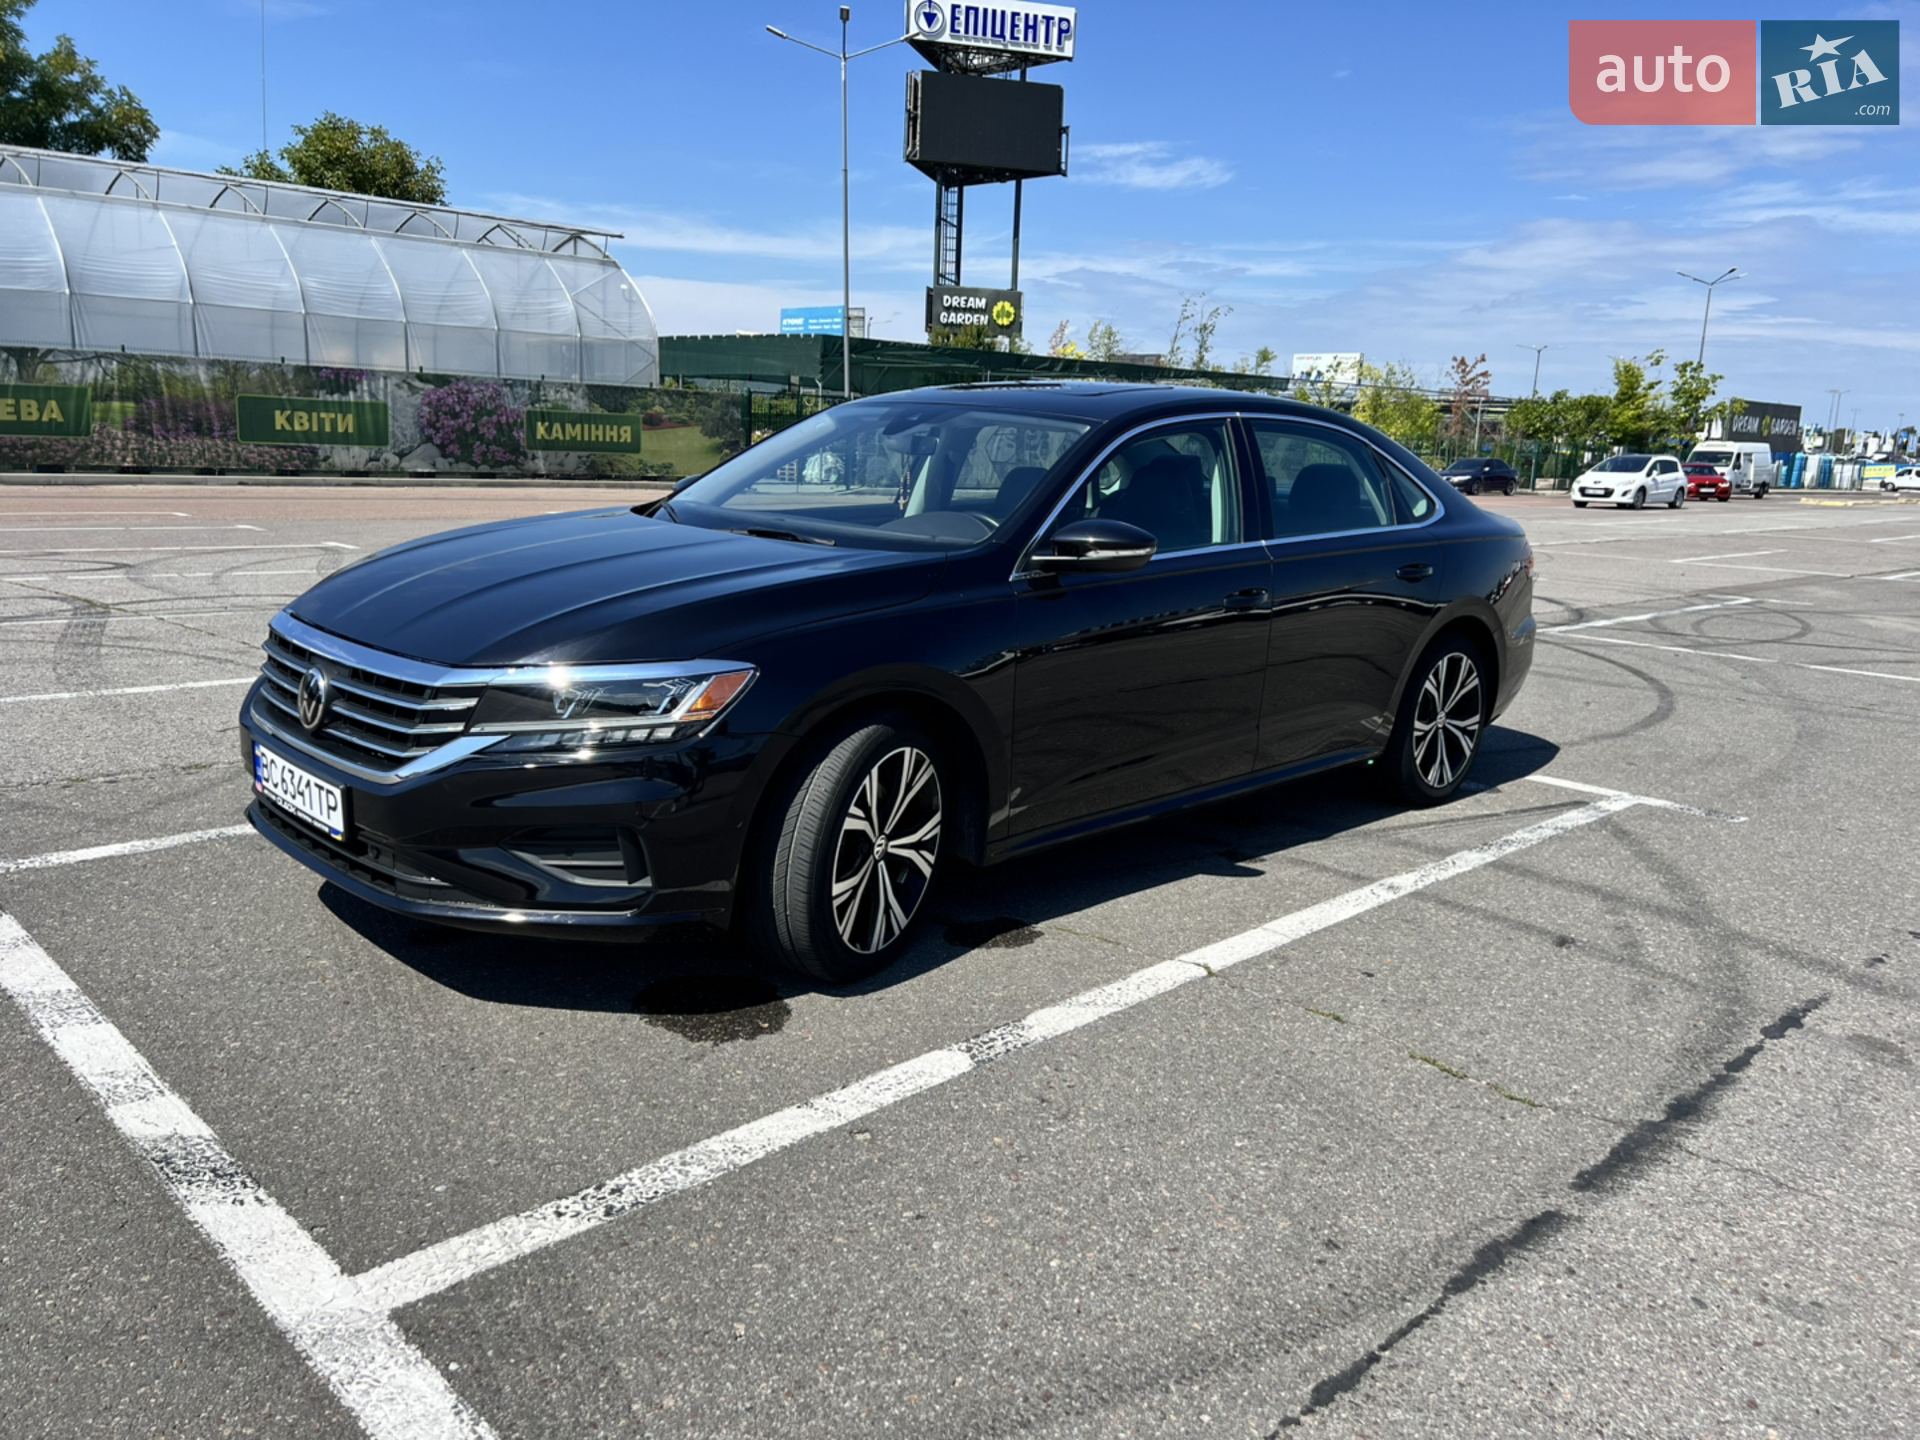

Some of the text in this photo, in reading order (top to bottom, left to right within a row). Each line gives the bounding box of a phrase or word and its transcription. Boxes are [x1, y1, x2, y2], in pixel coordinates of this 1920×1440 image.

[949, 3, 1071, 46] ЕПІЦЕНТР
[942, 294, 987, 310] DREAM
[939, 311, 989, 326] GARDEN
[274, 409, 355, 433] КВІТИ
[1732, 415, 1760, 433] DREAM
[536, 421, 632, 443] КАМІННЯ
